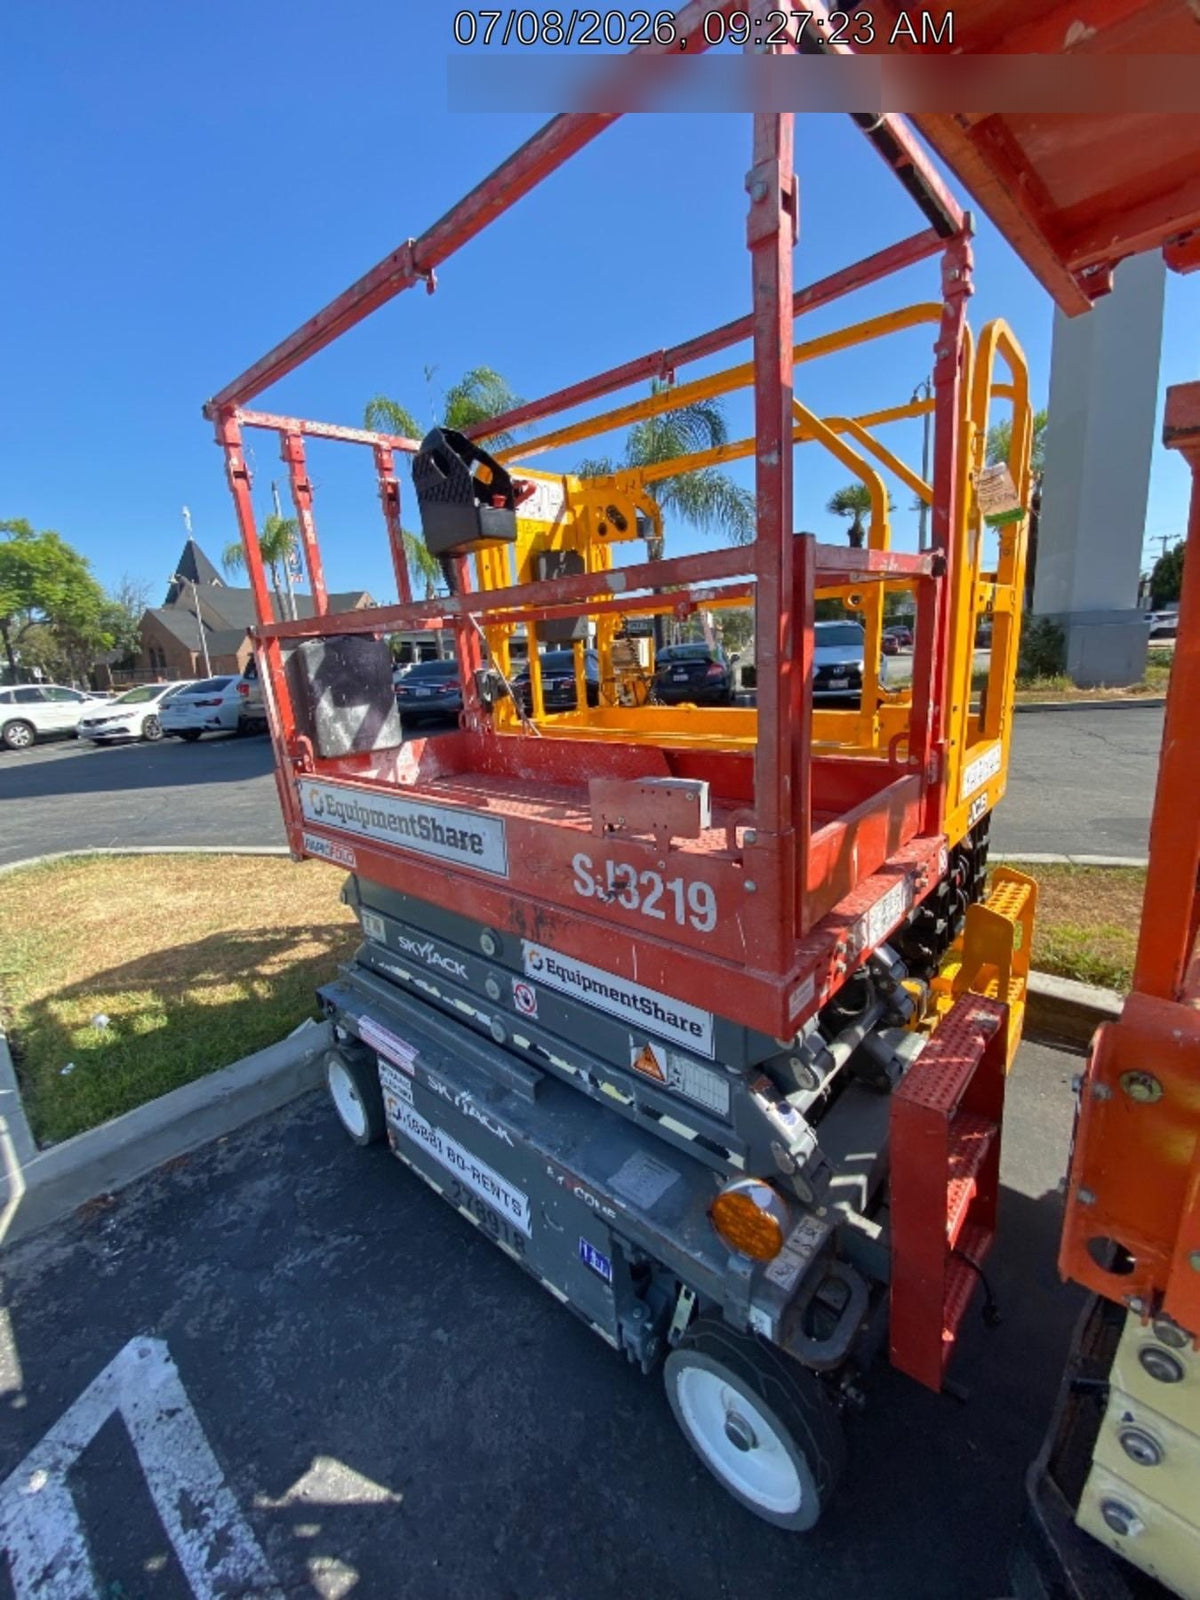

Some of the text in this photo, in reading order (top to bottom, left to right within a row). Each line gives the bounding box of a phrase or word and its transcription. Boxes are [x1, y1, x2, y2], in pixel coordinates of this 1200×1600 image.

[324, 794, 484, 855] EquipmentShare
[571, 852, 718, 933] SJ3219
[397, 935, 469, 980] SKYJACK
[545, 957, 703, 1037] EquipmentShare
